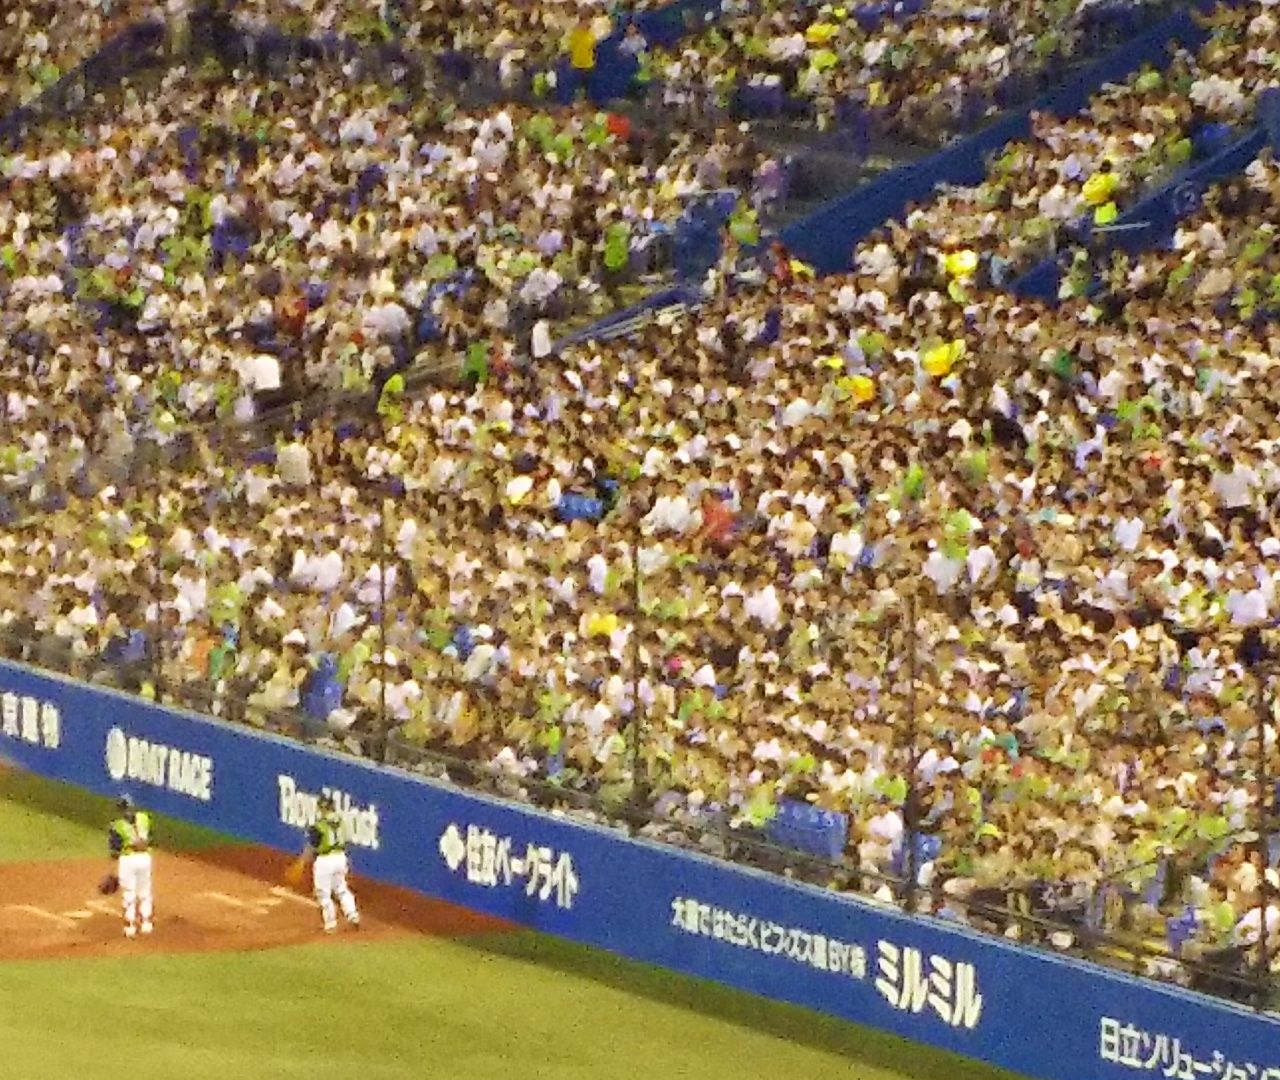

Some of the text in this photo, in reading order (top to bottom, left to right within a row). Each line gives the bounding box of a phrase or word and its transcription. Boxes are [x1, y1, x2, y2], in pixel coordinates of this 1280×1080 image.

[127, 736, 215, 801] BOAT RACE
[466, 823, 580, 910] 住友ベークライト
[875, 939, 983, 1030] ミルミル
